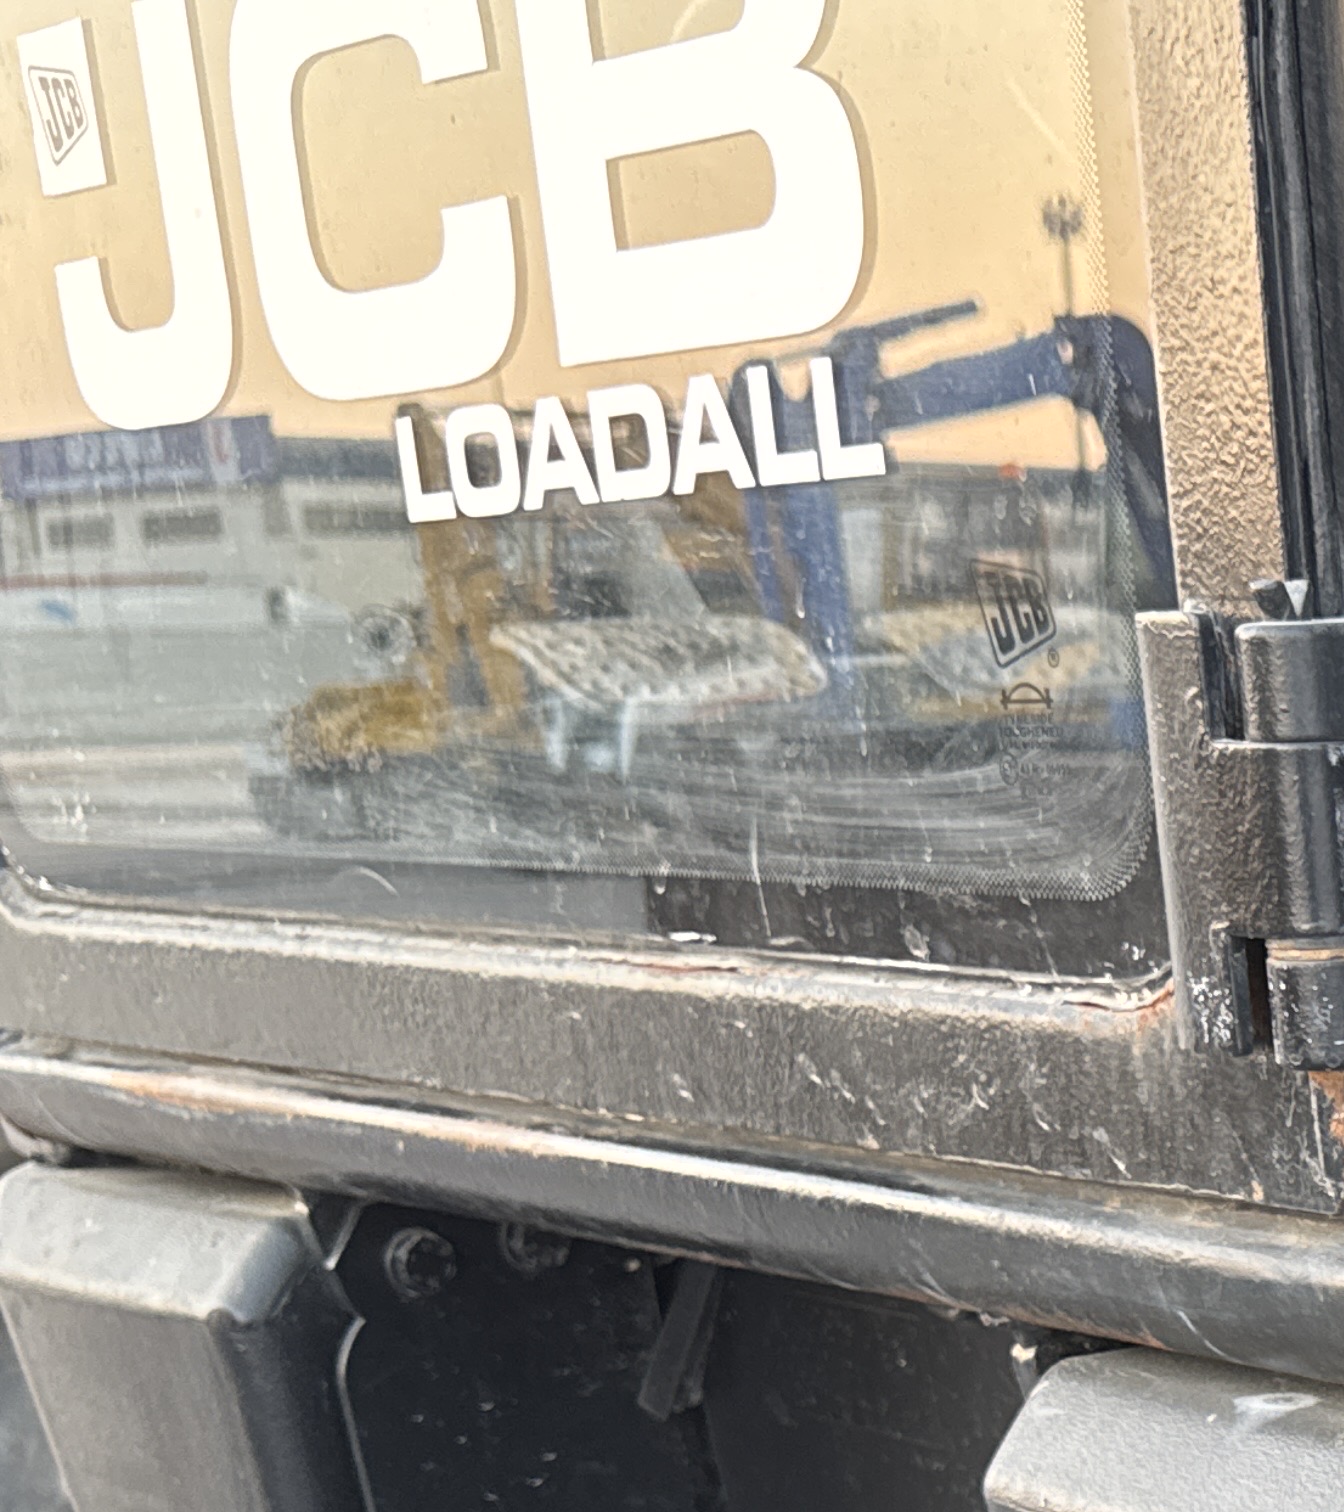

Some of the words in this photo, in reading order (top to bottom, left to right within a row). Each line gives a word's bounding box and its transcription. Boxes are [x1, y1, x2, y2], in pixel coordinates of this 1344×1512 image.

[38, 76, 84, 153] JCB
[54, 0, 865, 430] JCB
[395, 357, 887, 523] LOADALL
[982, 571, 1051, 655] JCB
